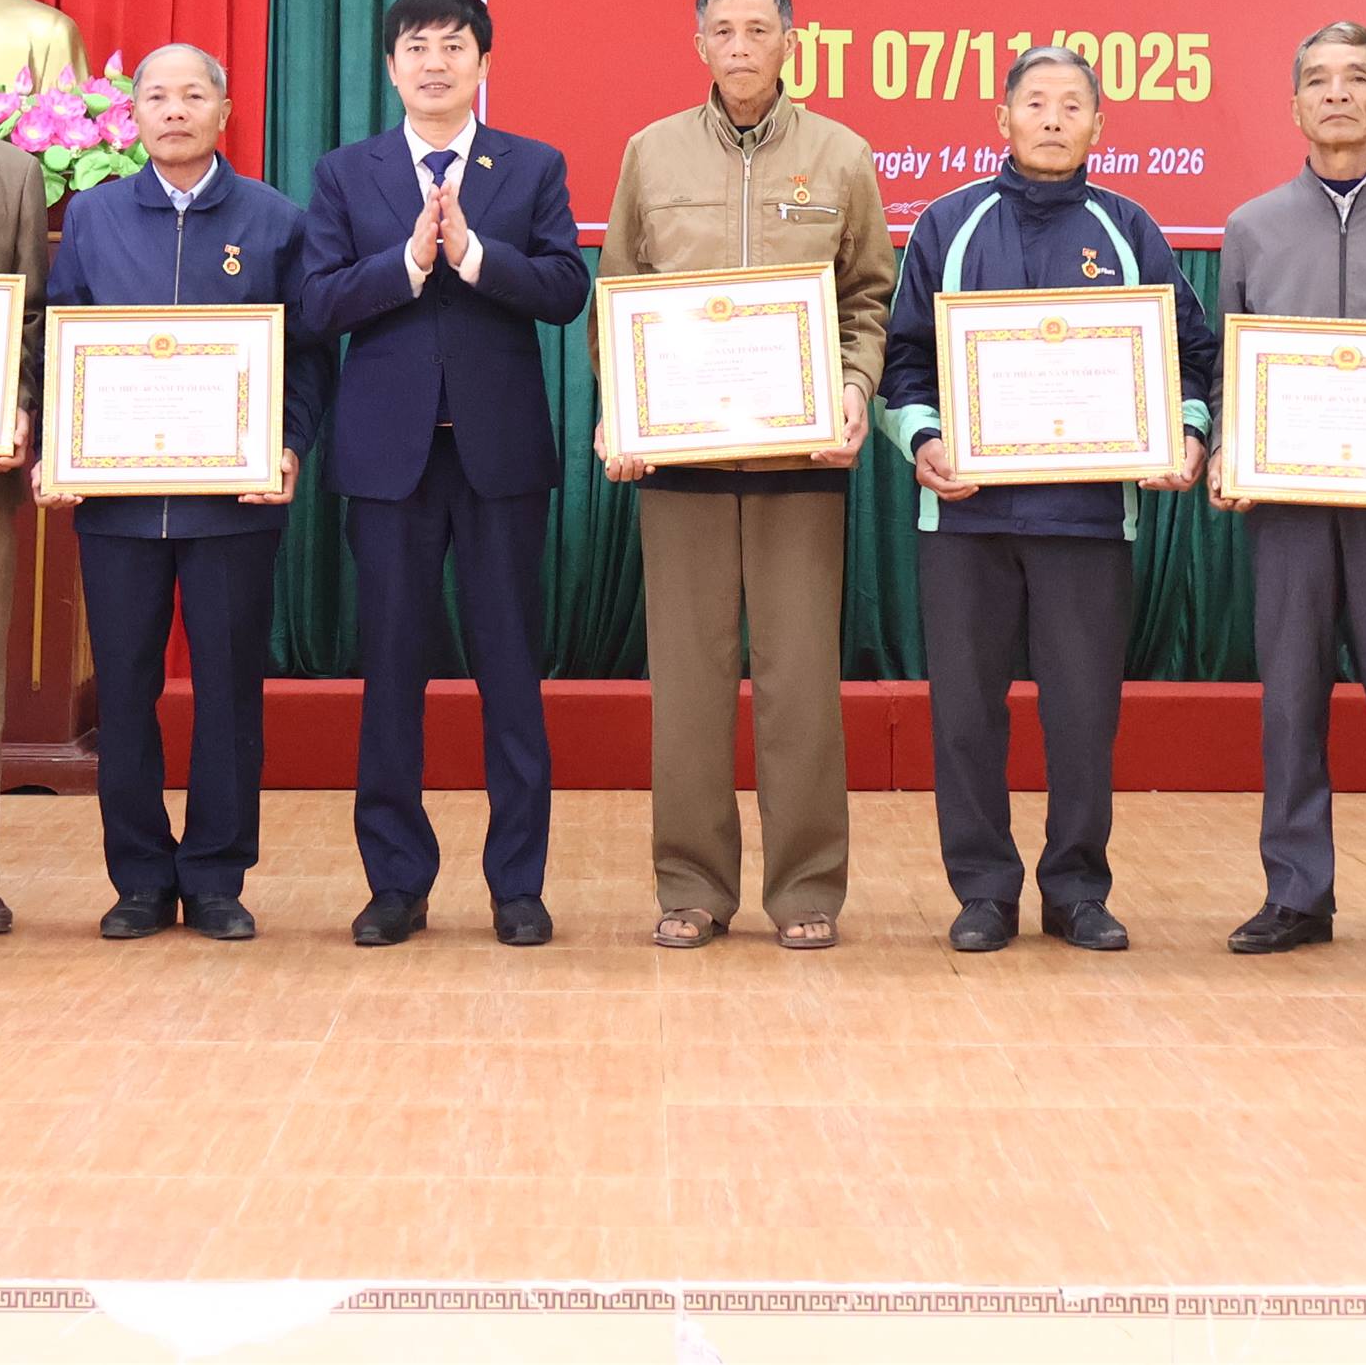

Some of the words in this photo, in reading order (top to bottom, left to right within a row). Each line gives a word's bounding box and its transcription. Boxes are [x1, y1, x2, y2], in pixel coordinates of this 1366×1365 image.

[779, 21, 854, 109] ỢT
[871, 29, 1212, 102] 07/1025
[871, 145, 932, 180] ngày
[938, 145, 966, 173] 14
[1086, 146, 1140, 174] năm
[1146, 147, 1205, 175] 2026
